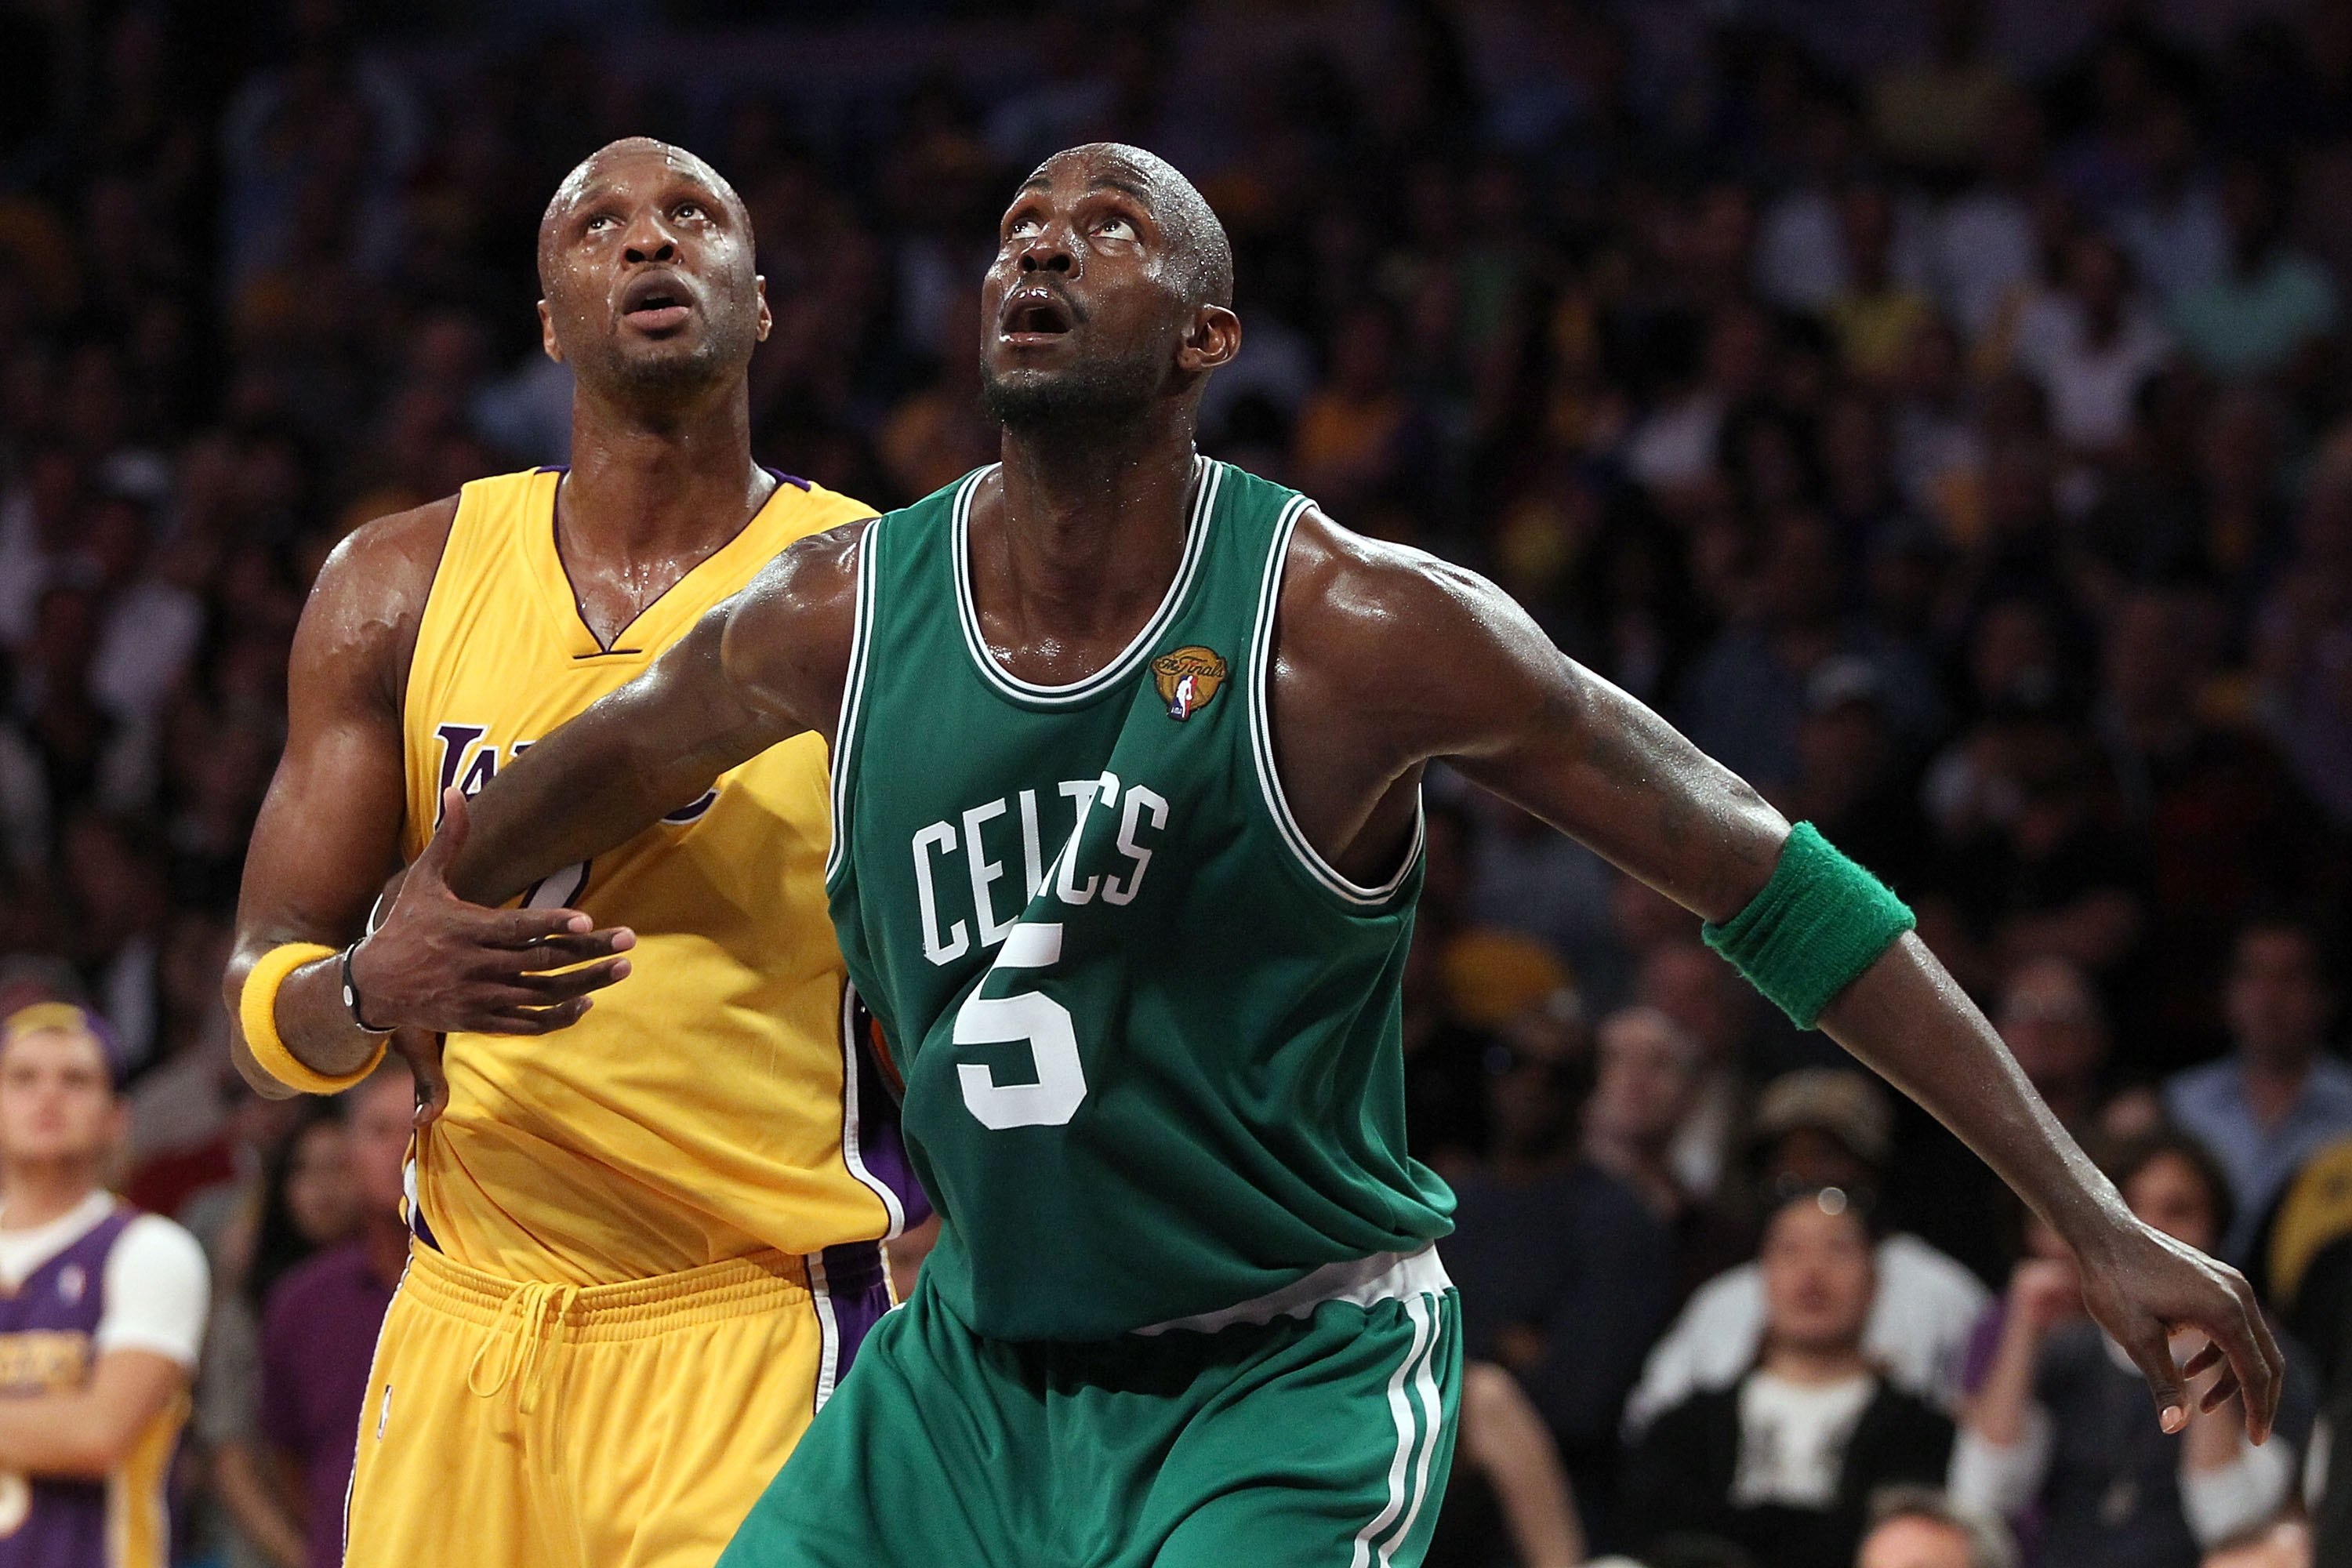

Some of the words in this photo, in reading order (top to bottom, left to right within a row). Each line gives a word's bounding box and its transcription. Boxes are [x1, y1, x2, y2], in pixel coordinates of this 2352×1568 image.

[1178, 655, 1224, 678] Finals
[912, 770, 1170, 966] CELTCS
[953, 922, 1087, 1131] 5
